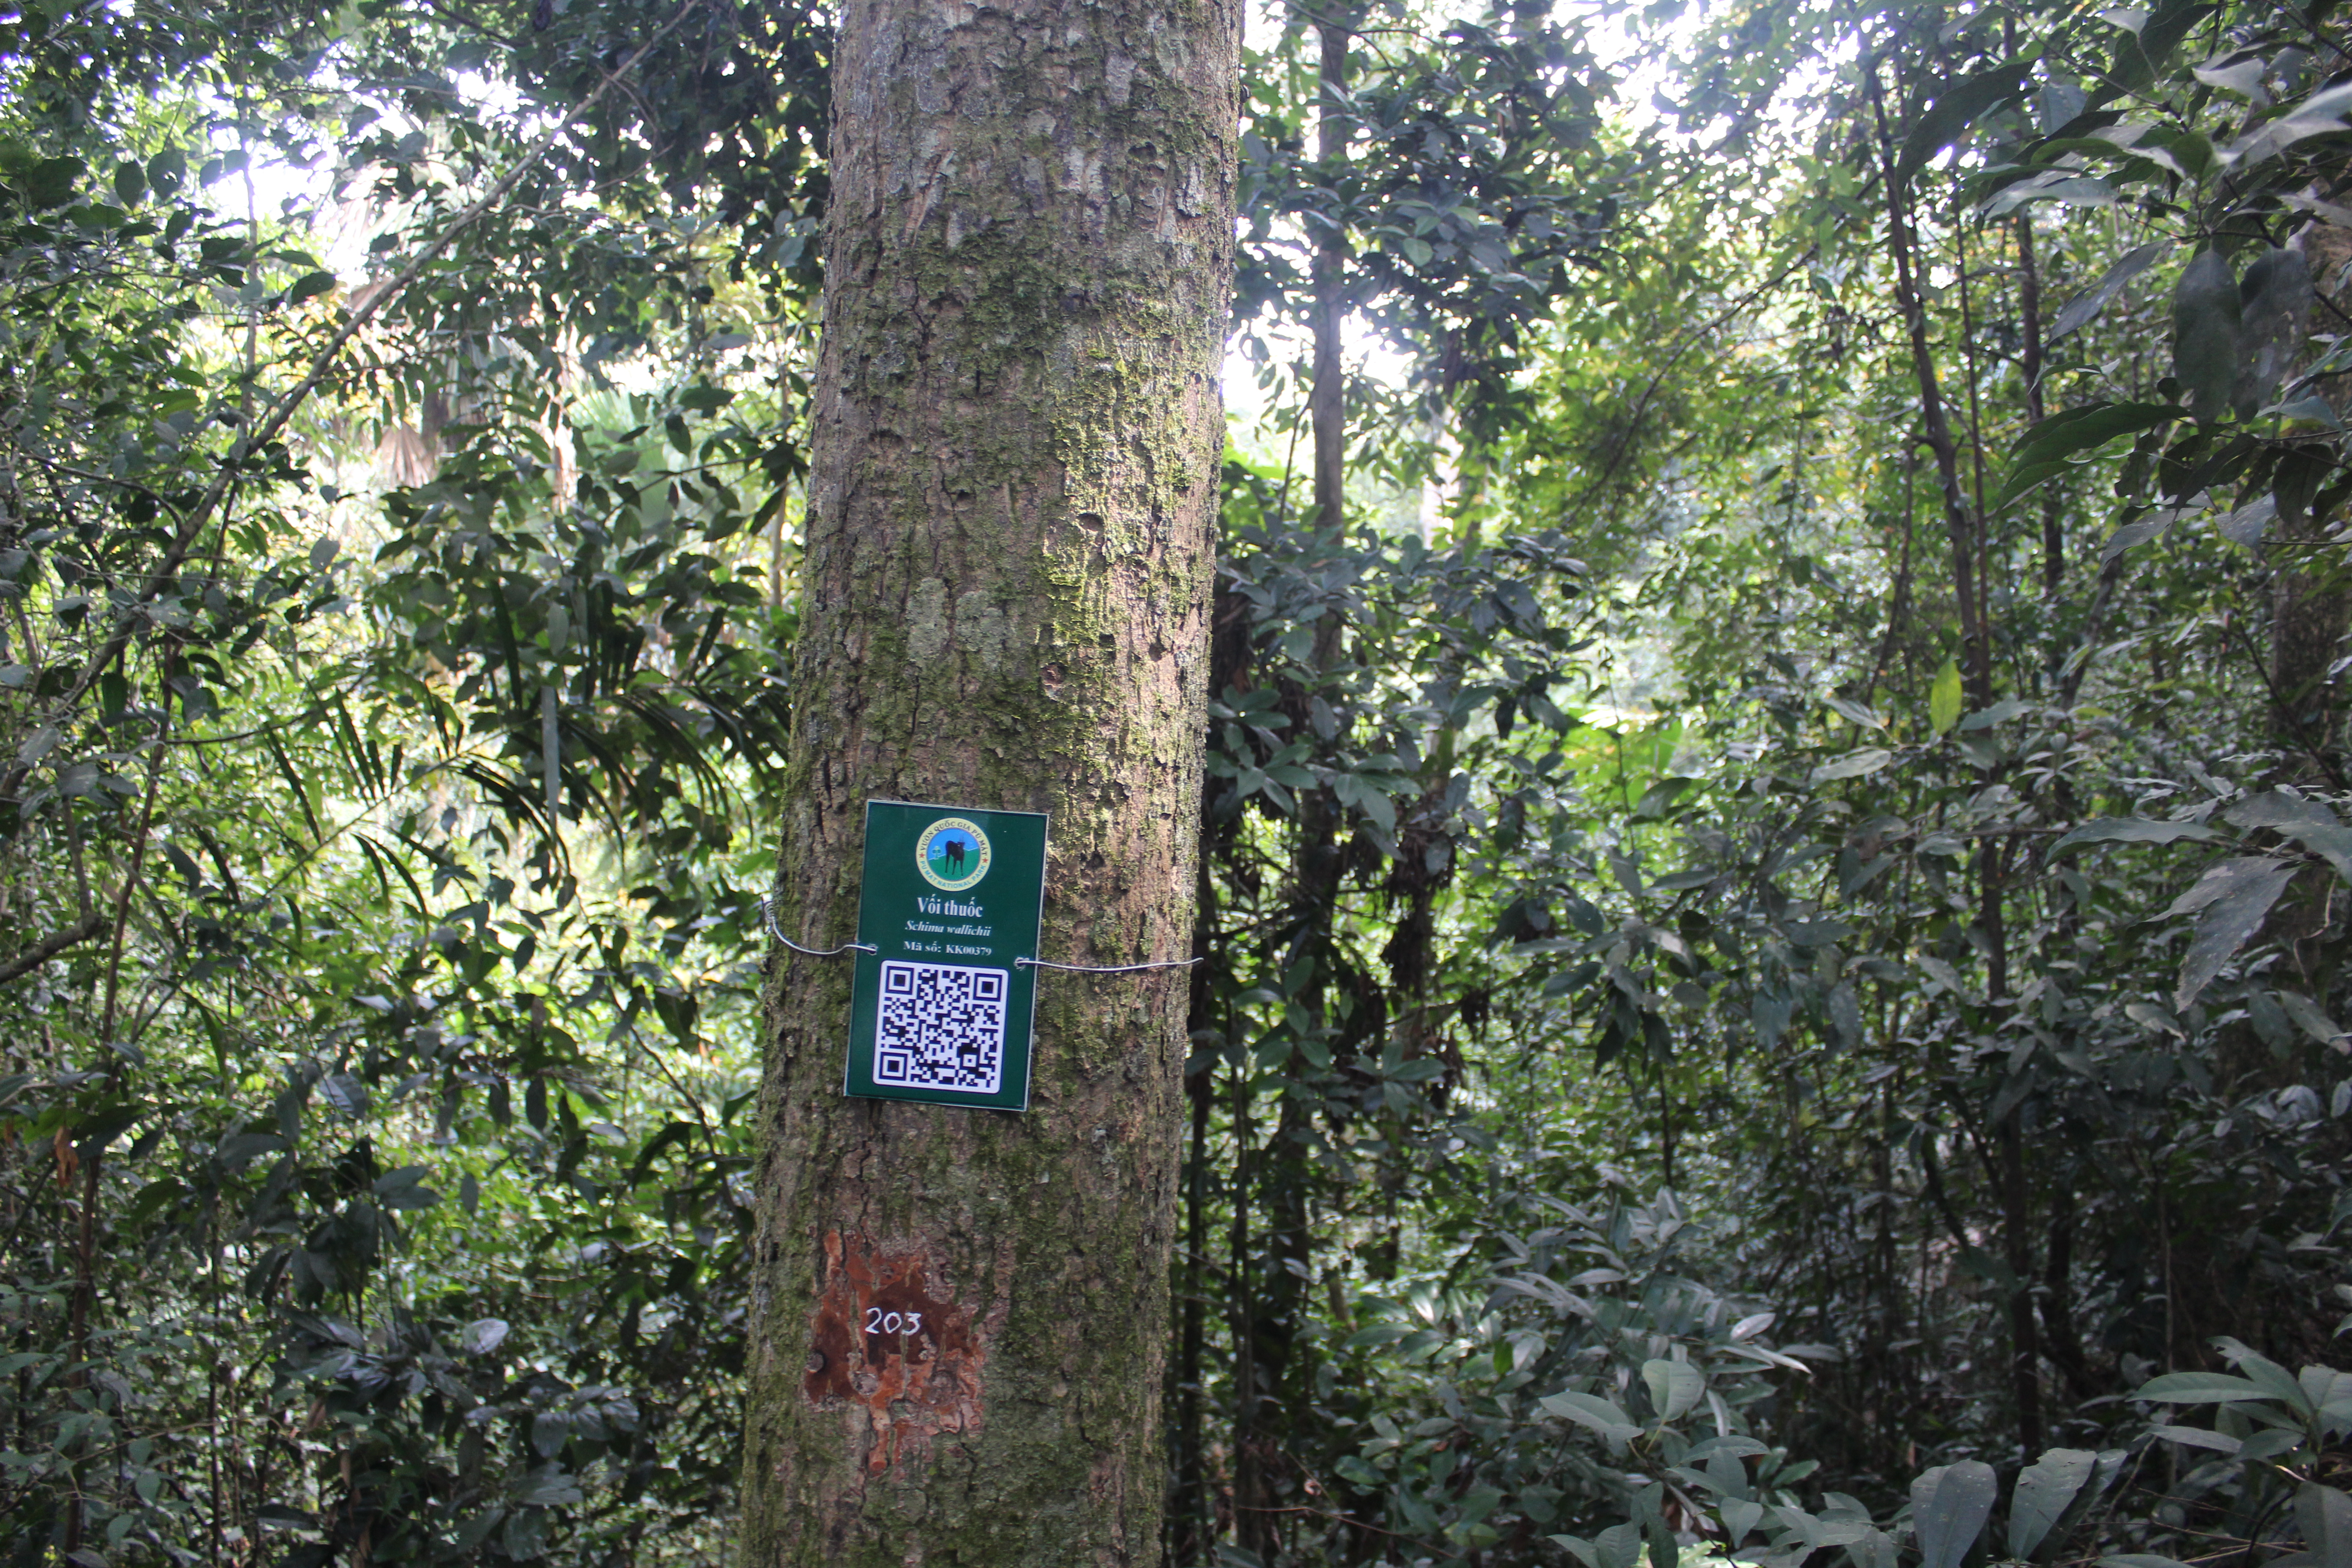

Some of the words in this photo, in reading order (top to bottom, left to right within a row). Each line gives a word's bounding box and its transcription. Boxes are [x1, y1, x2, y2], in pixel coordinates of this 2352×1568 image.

[935, 820, 956, 832] QUỐC
[957, 822, 971, 831] GIA
[920, 861, 927, 870] PU
[925, 870, 936, 882] MAT
[936, 881, 972, 889] NATIONAL
[971, 865, 986, 881] PARK
[917, 893, 941, 914] Vối
[944, 897, 983, 917] thuốc
[905, 920, 944, 933] Schima
[947, 925, 992, 936] wallichii
[903, 941, 922, 951] Mã
[925, 941, 941, 953] số:
[946, 944, 992, 956] KK00379
[865, 1307, 922, 1336] 203
